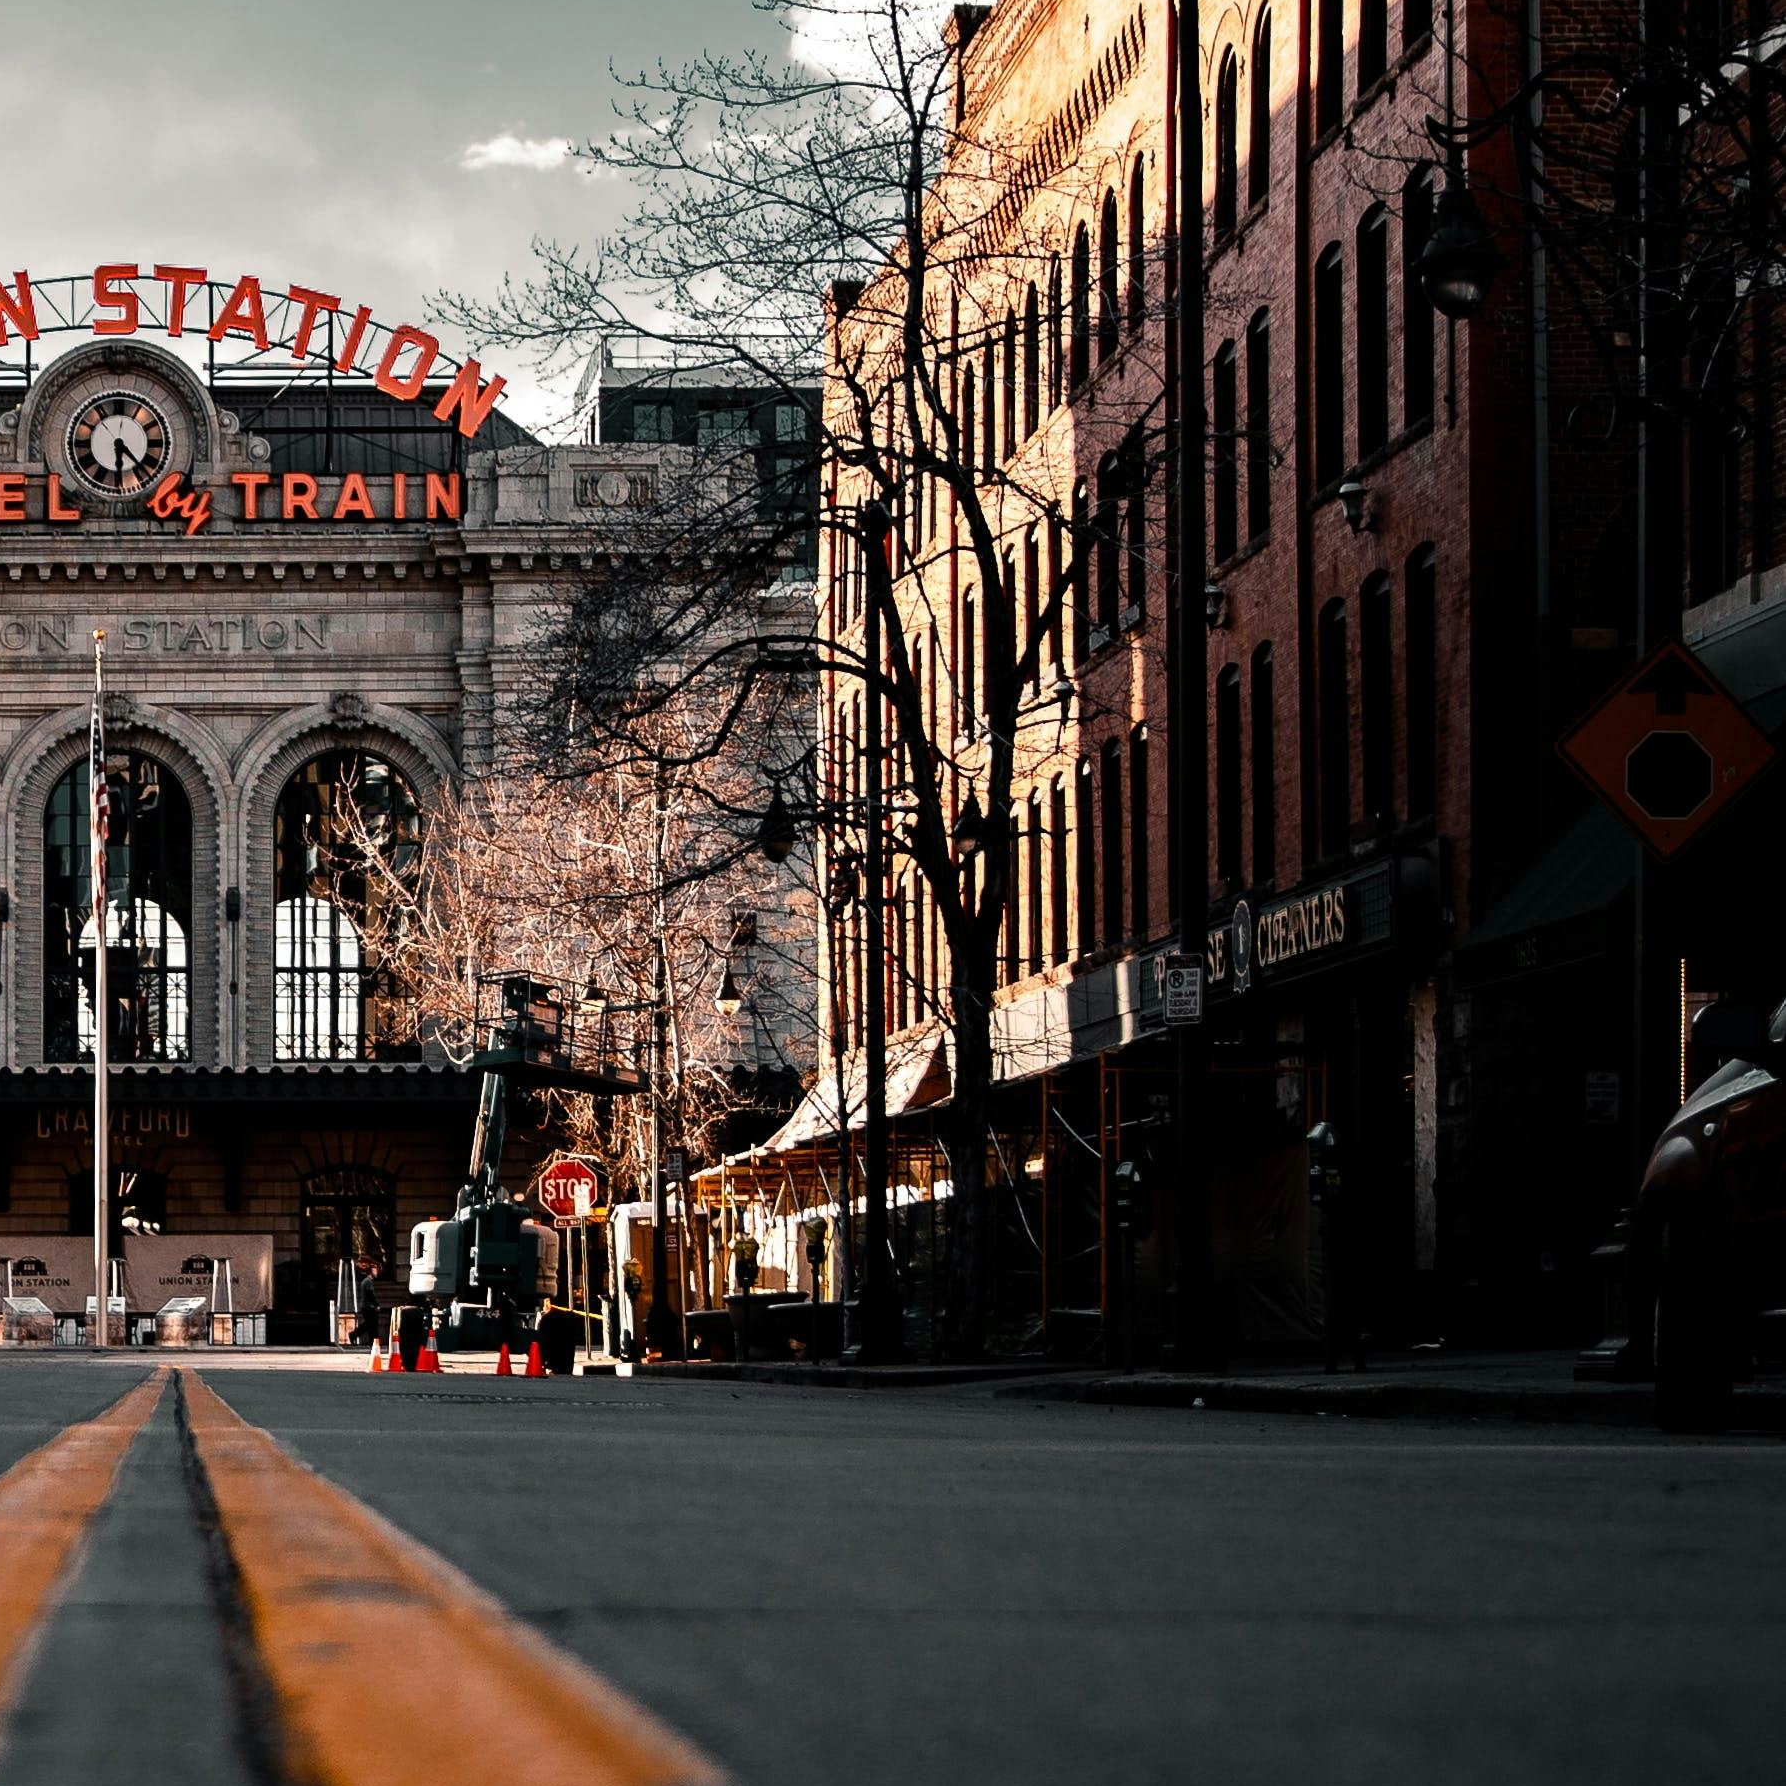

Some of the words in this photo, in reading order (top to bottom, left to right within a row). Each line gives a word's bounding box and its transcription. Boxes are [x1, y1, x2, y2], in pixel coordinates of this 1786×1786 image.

[92, 262, 509, 439] STATION
[146, 471, 212, 536] by
[232, 472, 463, 521] TRAIN
[123, 617, 329, 651] STATION
[1257, 886, 1346, 968] CLEANERS
[36, 1105, 191, 1139] CRAFORD
[83, 1135, 145, 1146] HTEL
[26, 1278, 71, 1287] STATION
[159, 1276, 193, 1286] UNION
